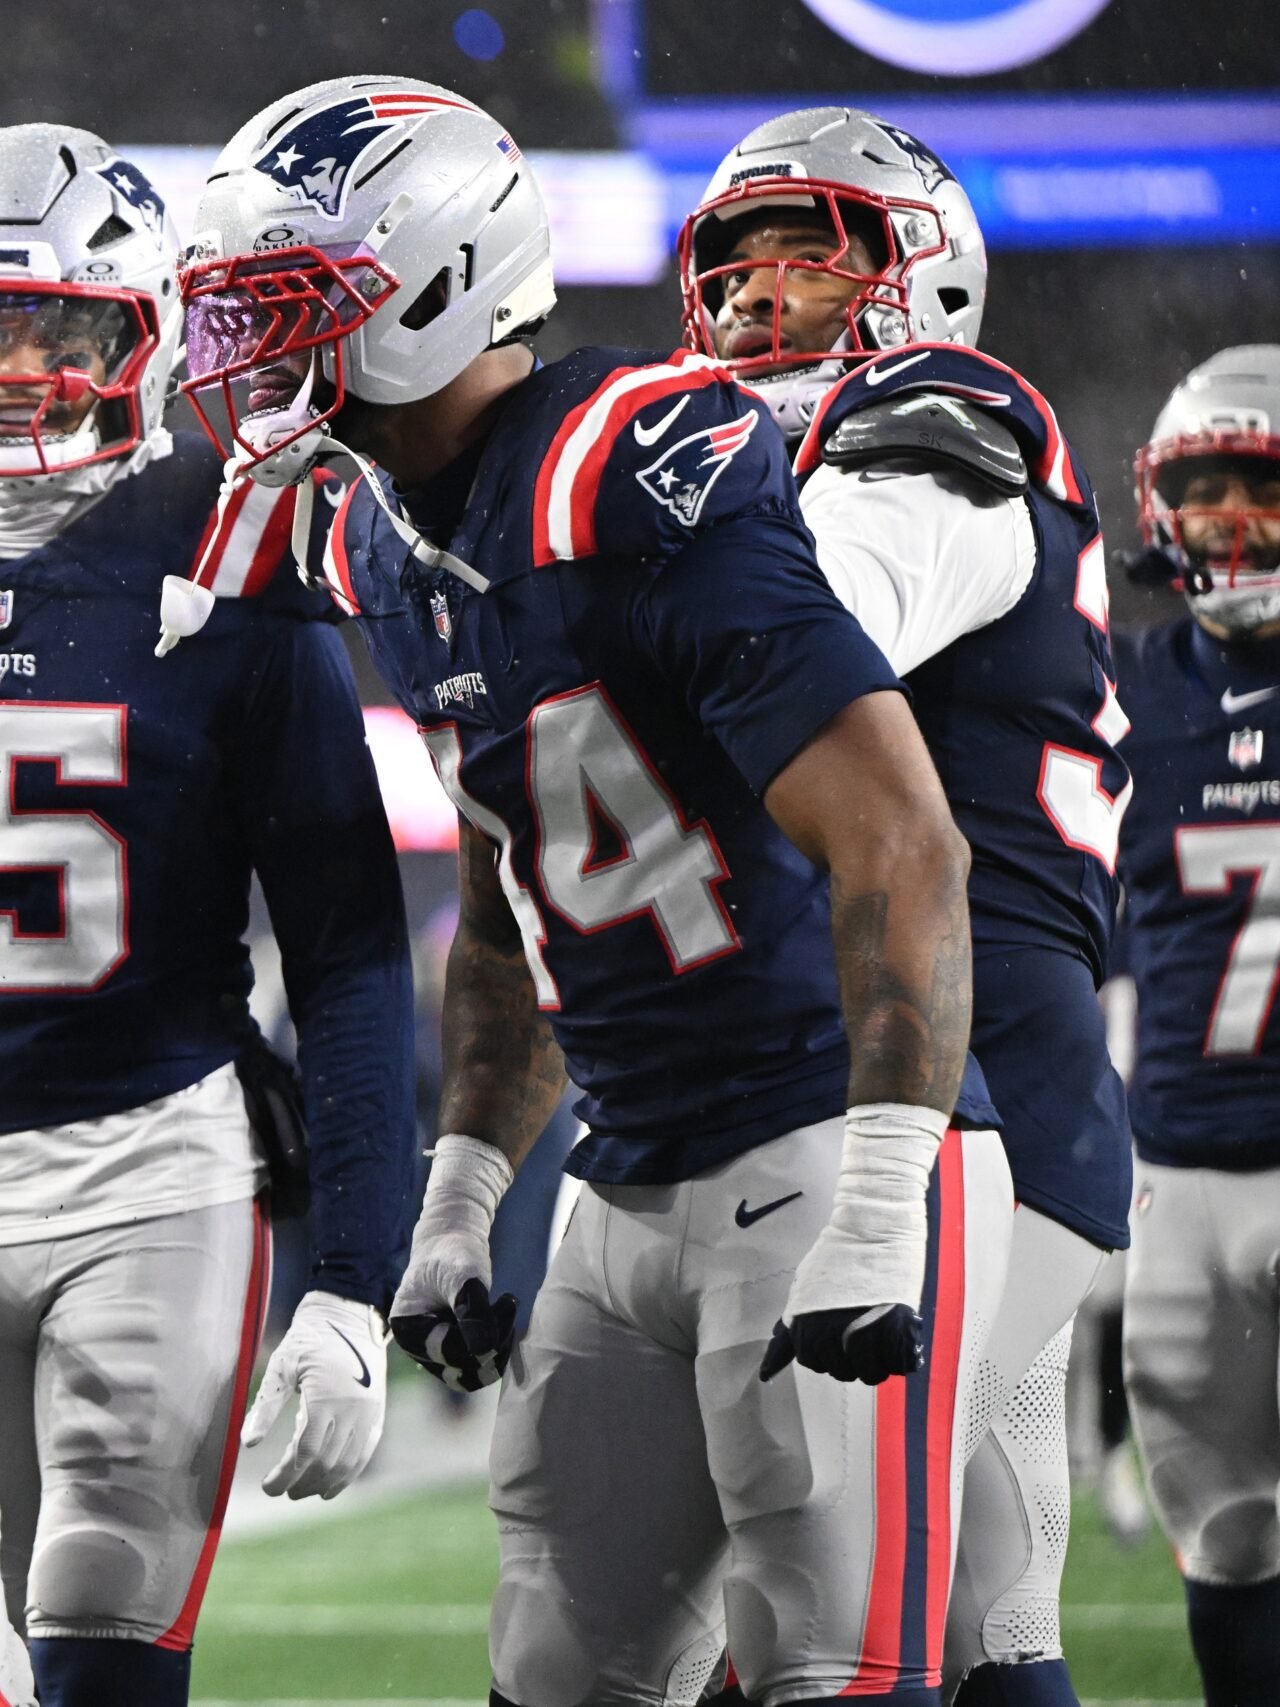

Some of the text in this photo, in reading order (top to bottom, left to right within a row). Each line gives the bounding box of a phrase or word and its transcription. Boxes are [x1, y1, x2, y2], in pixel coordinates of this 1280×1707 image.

[256, 239, 305, 252] OAKLEY
[77, 274, 120, 283] OAKLEY
[434, 672, 487, 710] PATRIOTS
[1202, 780, 1280, 812] PATRIOTS
[1173, 817, 1280, 1060] 7
